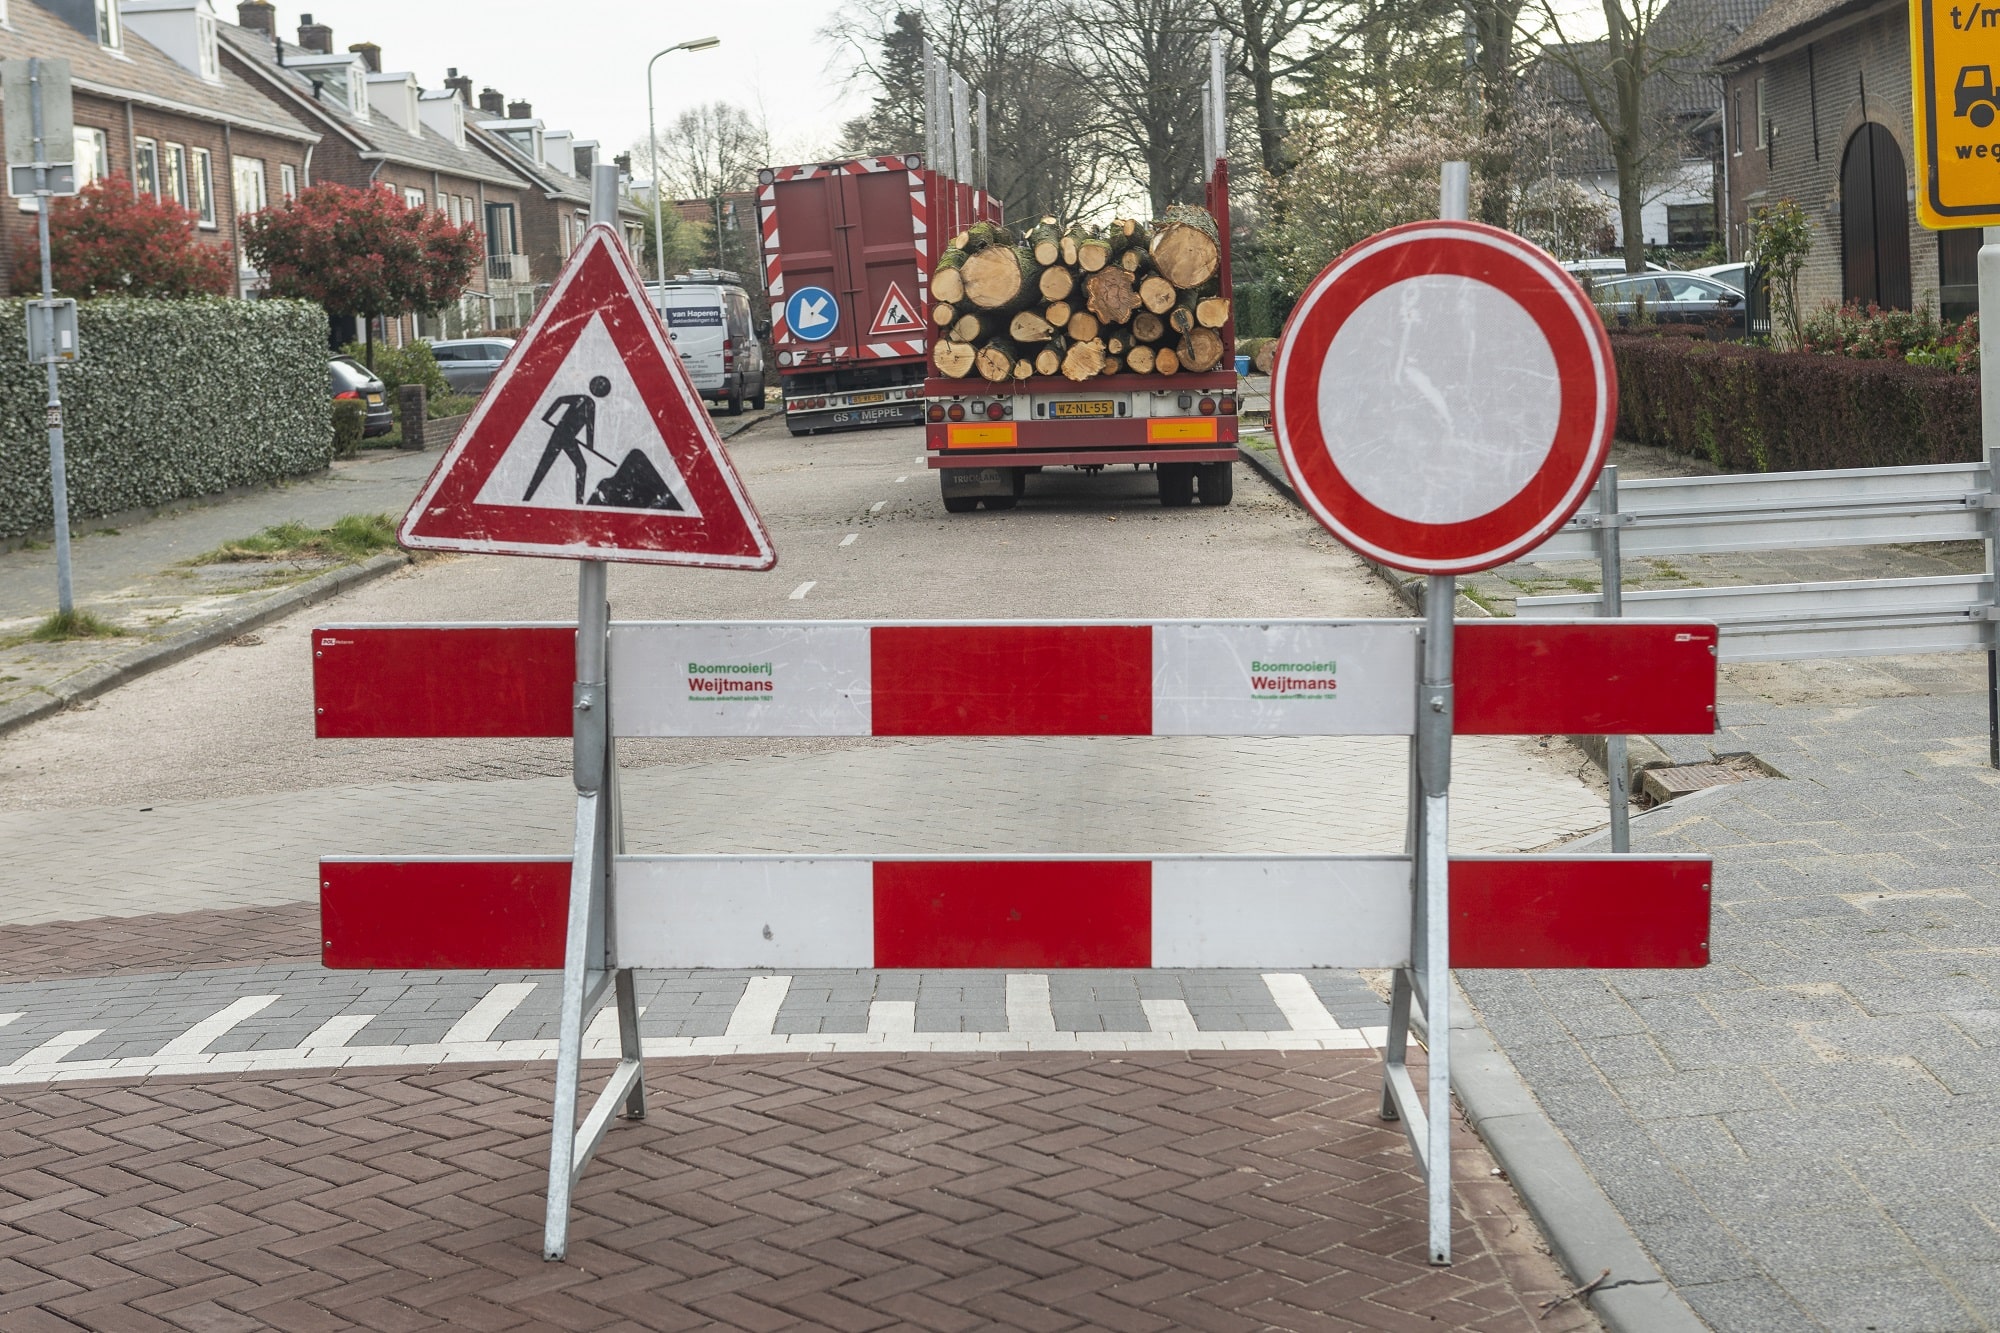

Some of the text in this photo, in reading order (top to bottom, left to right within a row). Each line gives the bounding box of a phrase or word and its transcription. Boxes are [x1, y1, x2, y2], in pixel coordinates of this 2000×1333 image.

[1950, 3, 2000, 32] t/m
[1955, 143, 2000, 163] weg
[687, 310, 719, 318] Haperen
[833, 413, 849, 423] GS
[861, 408, 903, 420] MEPPEL
[1058, 403, 1108, 414] WZ-NL-55
[688, 662, 773, 676] Boomrooierij
[1251, 661, 1337, 675] Boomrooierij
[688, 678, 774, 694] Weijtmans
[1251, 676, 1337, 693] Weijtmans
